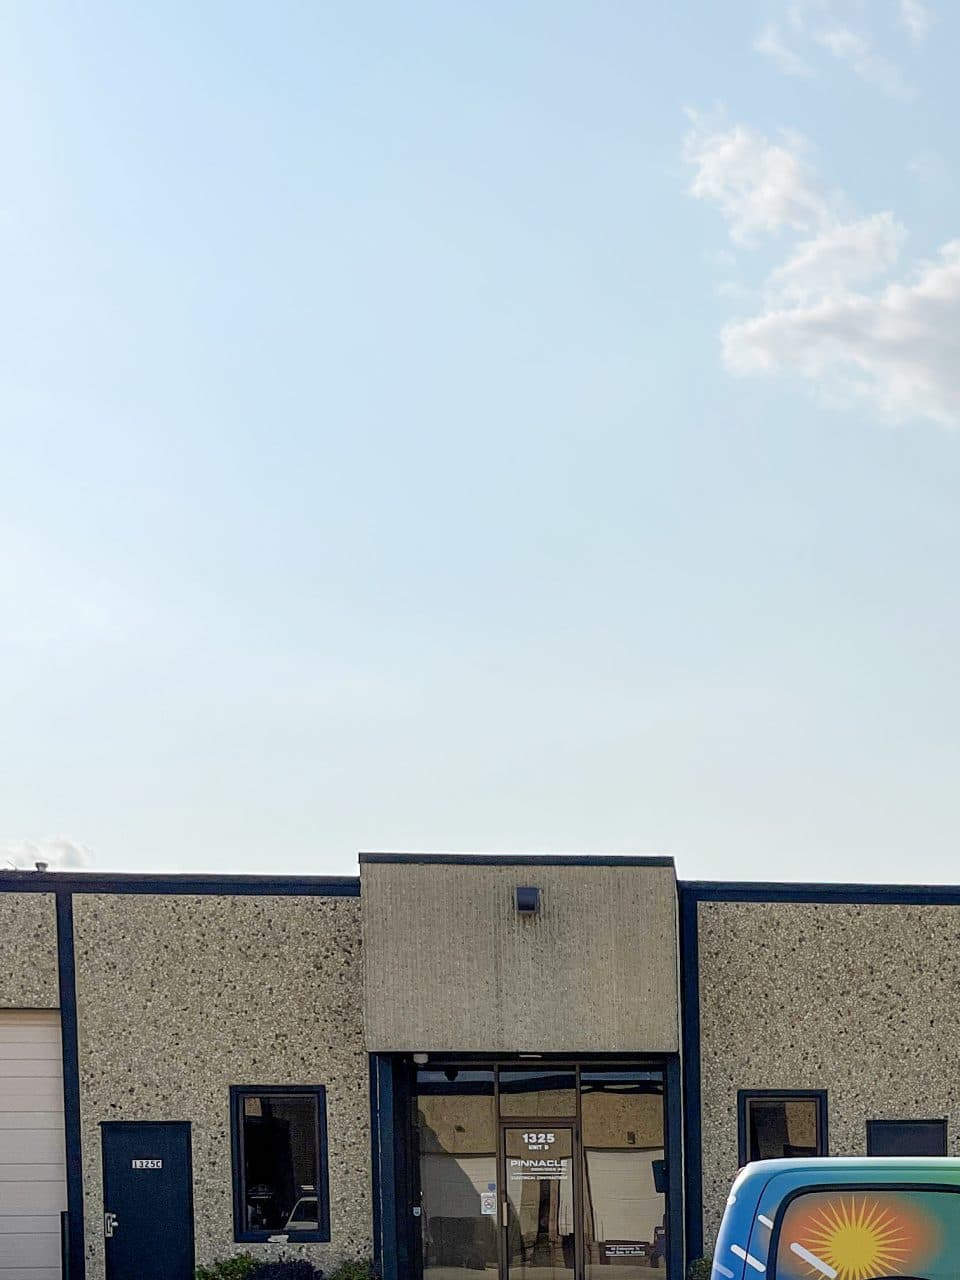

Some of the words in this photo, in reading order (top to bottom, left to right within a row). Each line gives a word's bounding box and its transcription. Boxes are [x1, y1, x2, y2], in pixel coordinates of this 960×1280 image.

[522, 1133, 555, 1143] 1325
[133, 1160, 161, 1168] 1325C
[510, 1159, 568, 1167] PINNACLE
